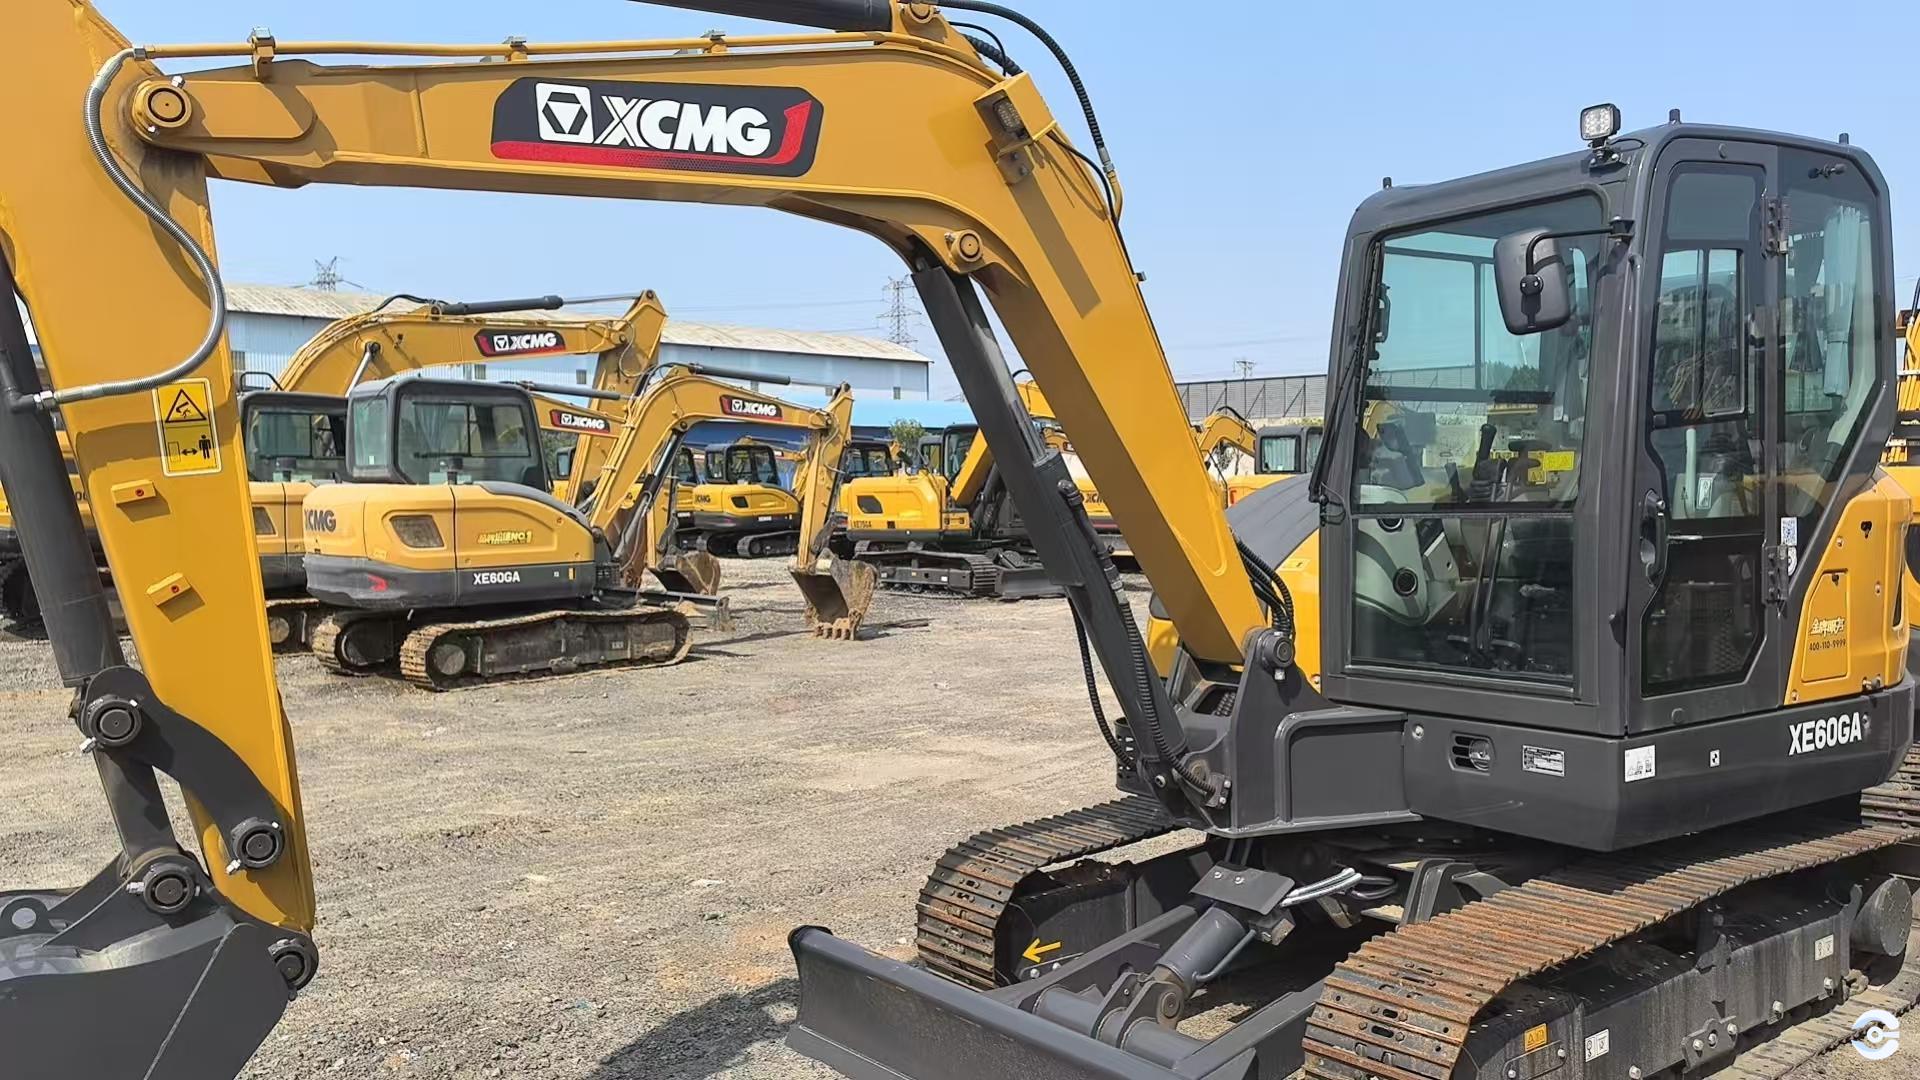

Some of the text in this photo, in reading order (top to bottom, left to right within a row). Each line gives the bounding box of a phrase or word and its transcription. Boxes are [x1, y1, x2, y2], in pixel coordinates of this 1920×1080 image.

[593, 95, 771, 156] XCMG
[510, 332, 557, 349] XCMG
[744, 401, 777, 416] XCMG
[572, 416, 605, 429] XCMG
[303, 508, 337, 532] XCMG
[473, 570, 521, 585] XE60GA
[1809, 638, 1847, 652] 400-110-9999
[1788, 711, 1863, 756] XE60GA
